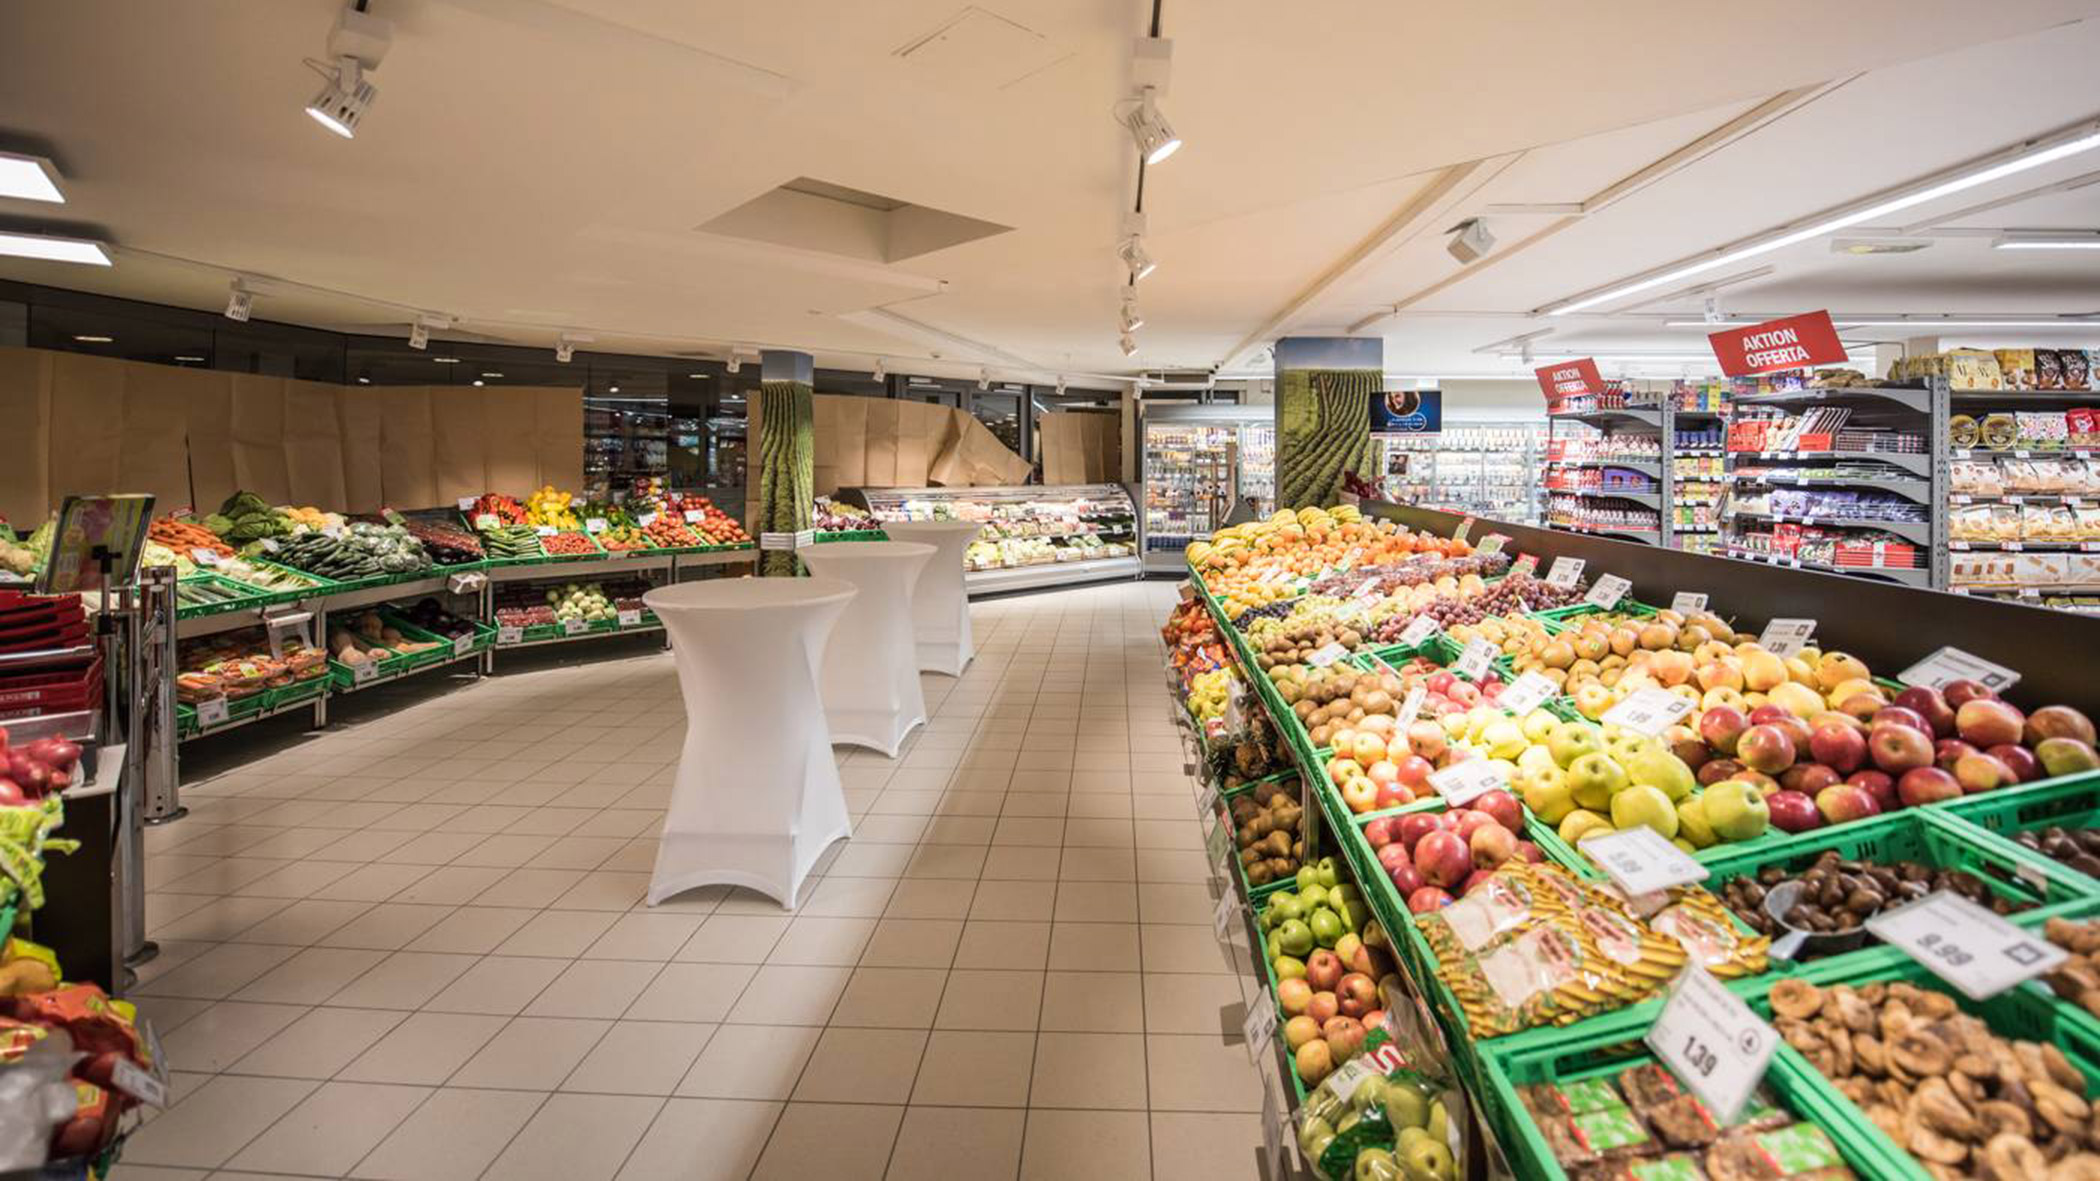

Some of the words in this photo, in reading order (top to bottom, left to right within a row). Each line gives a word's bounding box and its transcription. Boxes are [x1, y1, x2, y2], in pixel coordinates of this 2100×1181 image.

[1743, 327, 1799, 352] AKTION
[1745, 346, 1811, 368] OFFERTA
[1552, 367, 1581, 382] AKTION
[1554, 379, 1590, 395] OFFERTA
[1916, 933, 1975, 967] 9.99
[1683, 1036, 1718, 1078] 1.39
